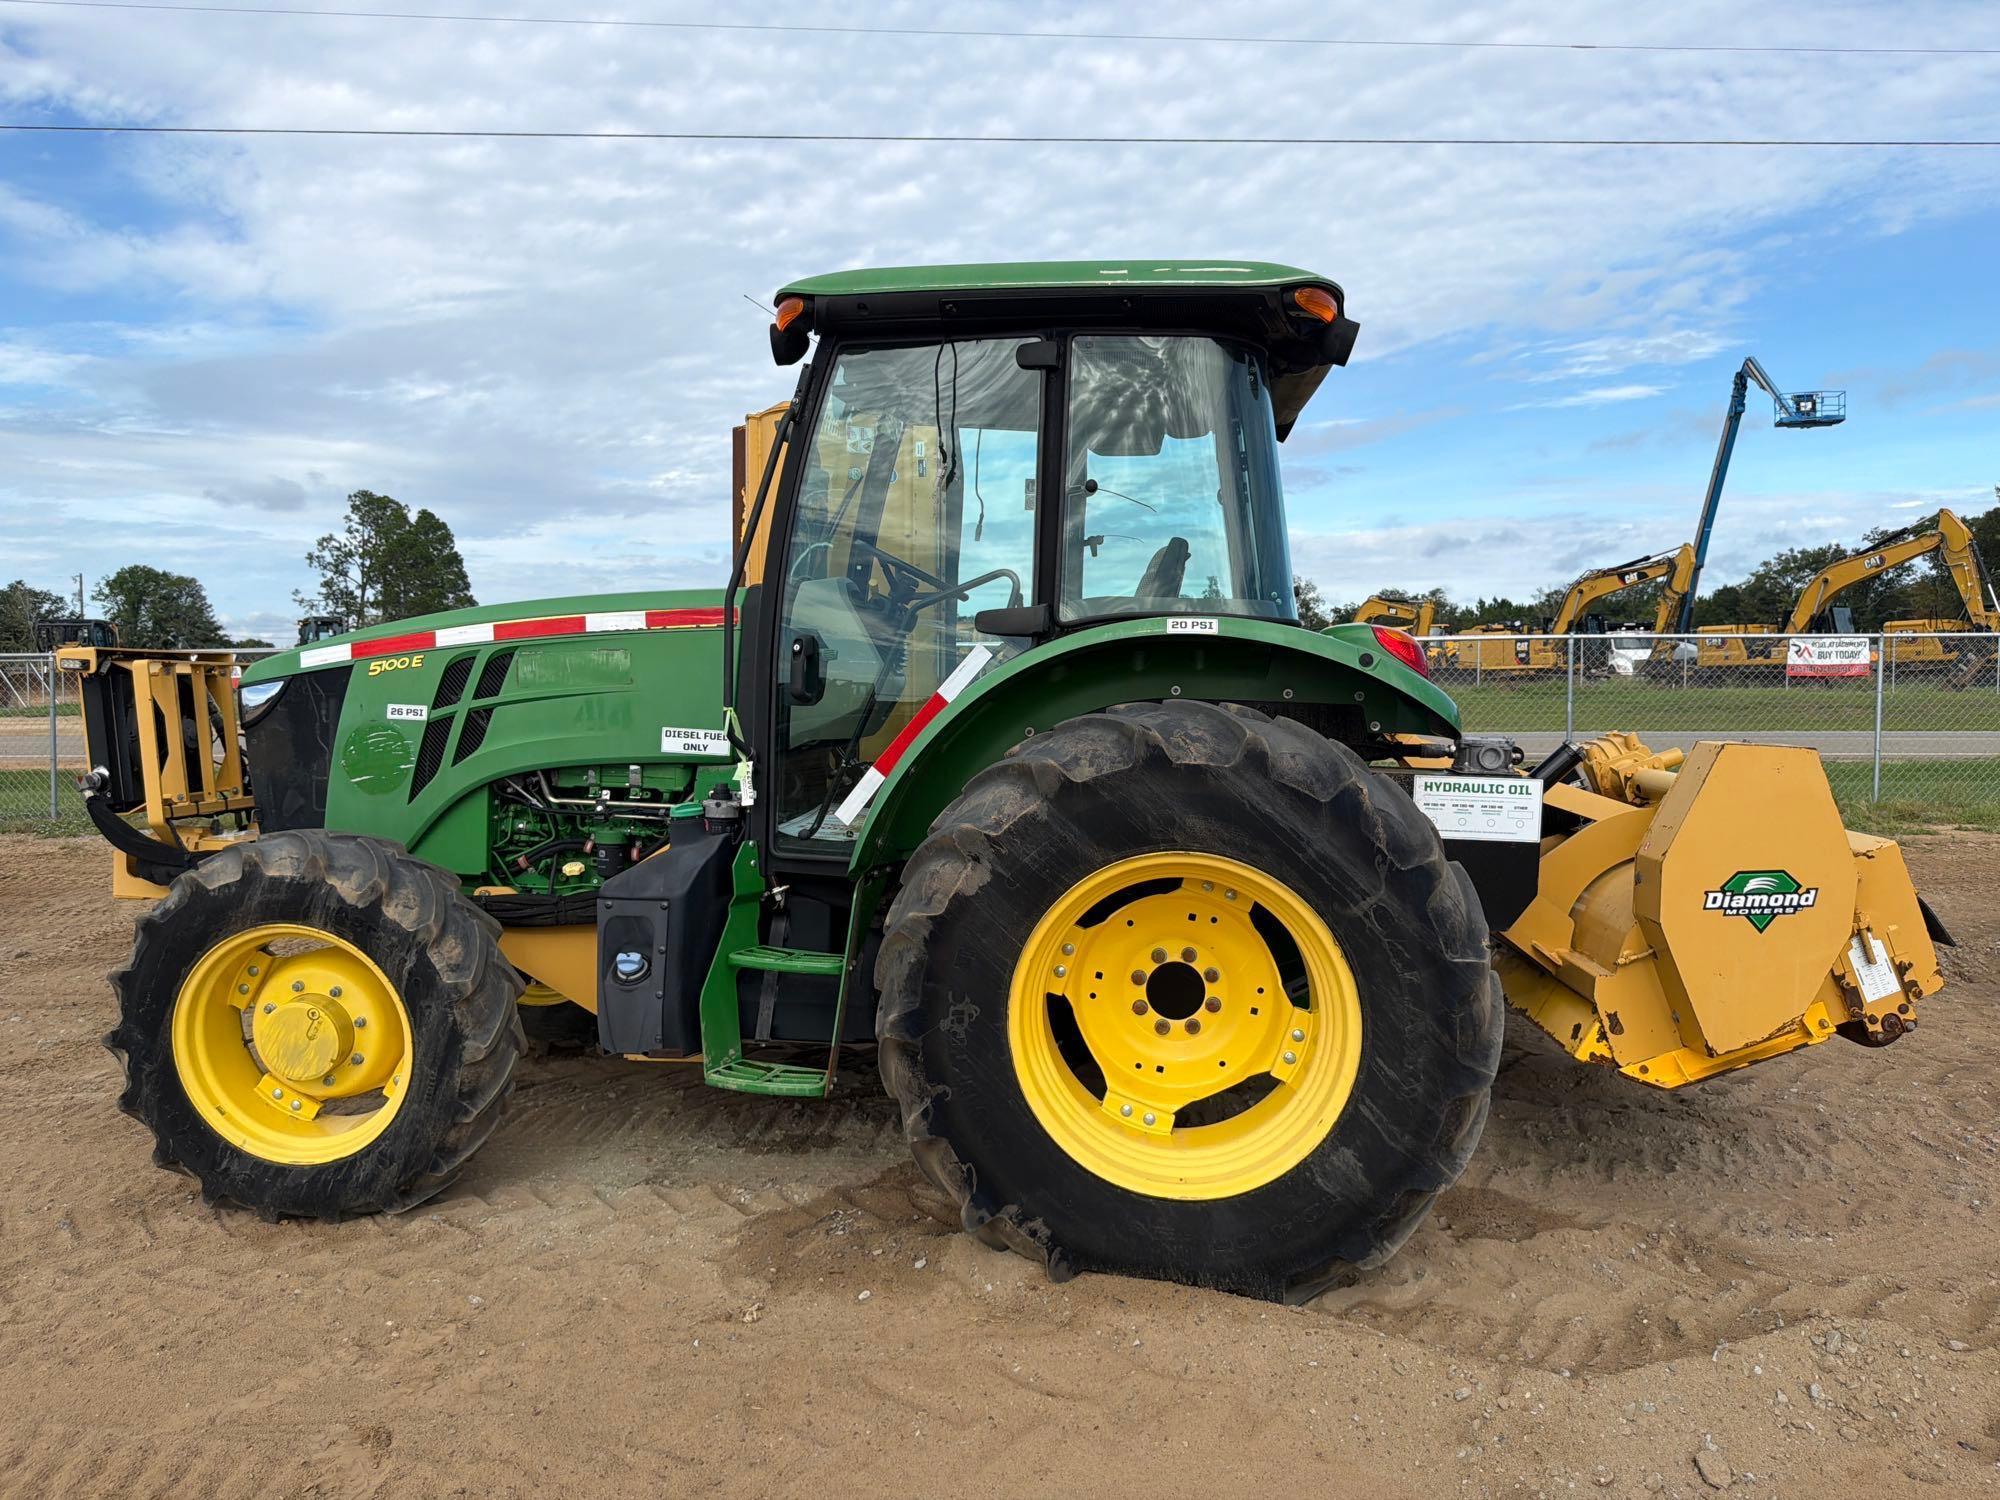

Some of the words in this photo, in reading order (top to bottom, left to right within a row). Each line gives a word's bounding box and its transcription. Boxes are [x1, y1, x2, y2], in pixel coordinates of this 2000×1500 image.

[1864, 555, 1880, 569] CAT
[1625, 572, 1638, 584] CAT
[1171, 621, 1188, 629] 20
[1191, 621, 1213, 630] PSI
[1516, 641, 1528, 651] CAT
[1817, 651, 1833, 660] BUY
[368, 657, 410, 676] 5100
[411, 654, 426, 669] E
[390, 707, 404, 716] 26
[405, 708, 424, 717] PSI
[664, 729, 702, 740] DIESEL
[682, 743, 709, 752] ONLY
[1424, 781, 1504, 794] HYDRAULIC
[1508, 784, 1532, 795] OIL
[1705, 889, 1817, 909] Diamond
[1725, 907, 1795, 915] MOWERS
